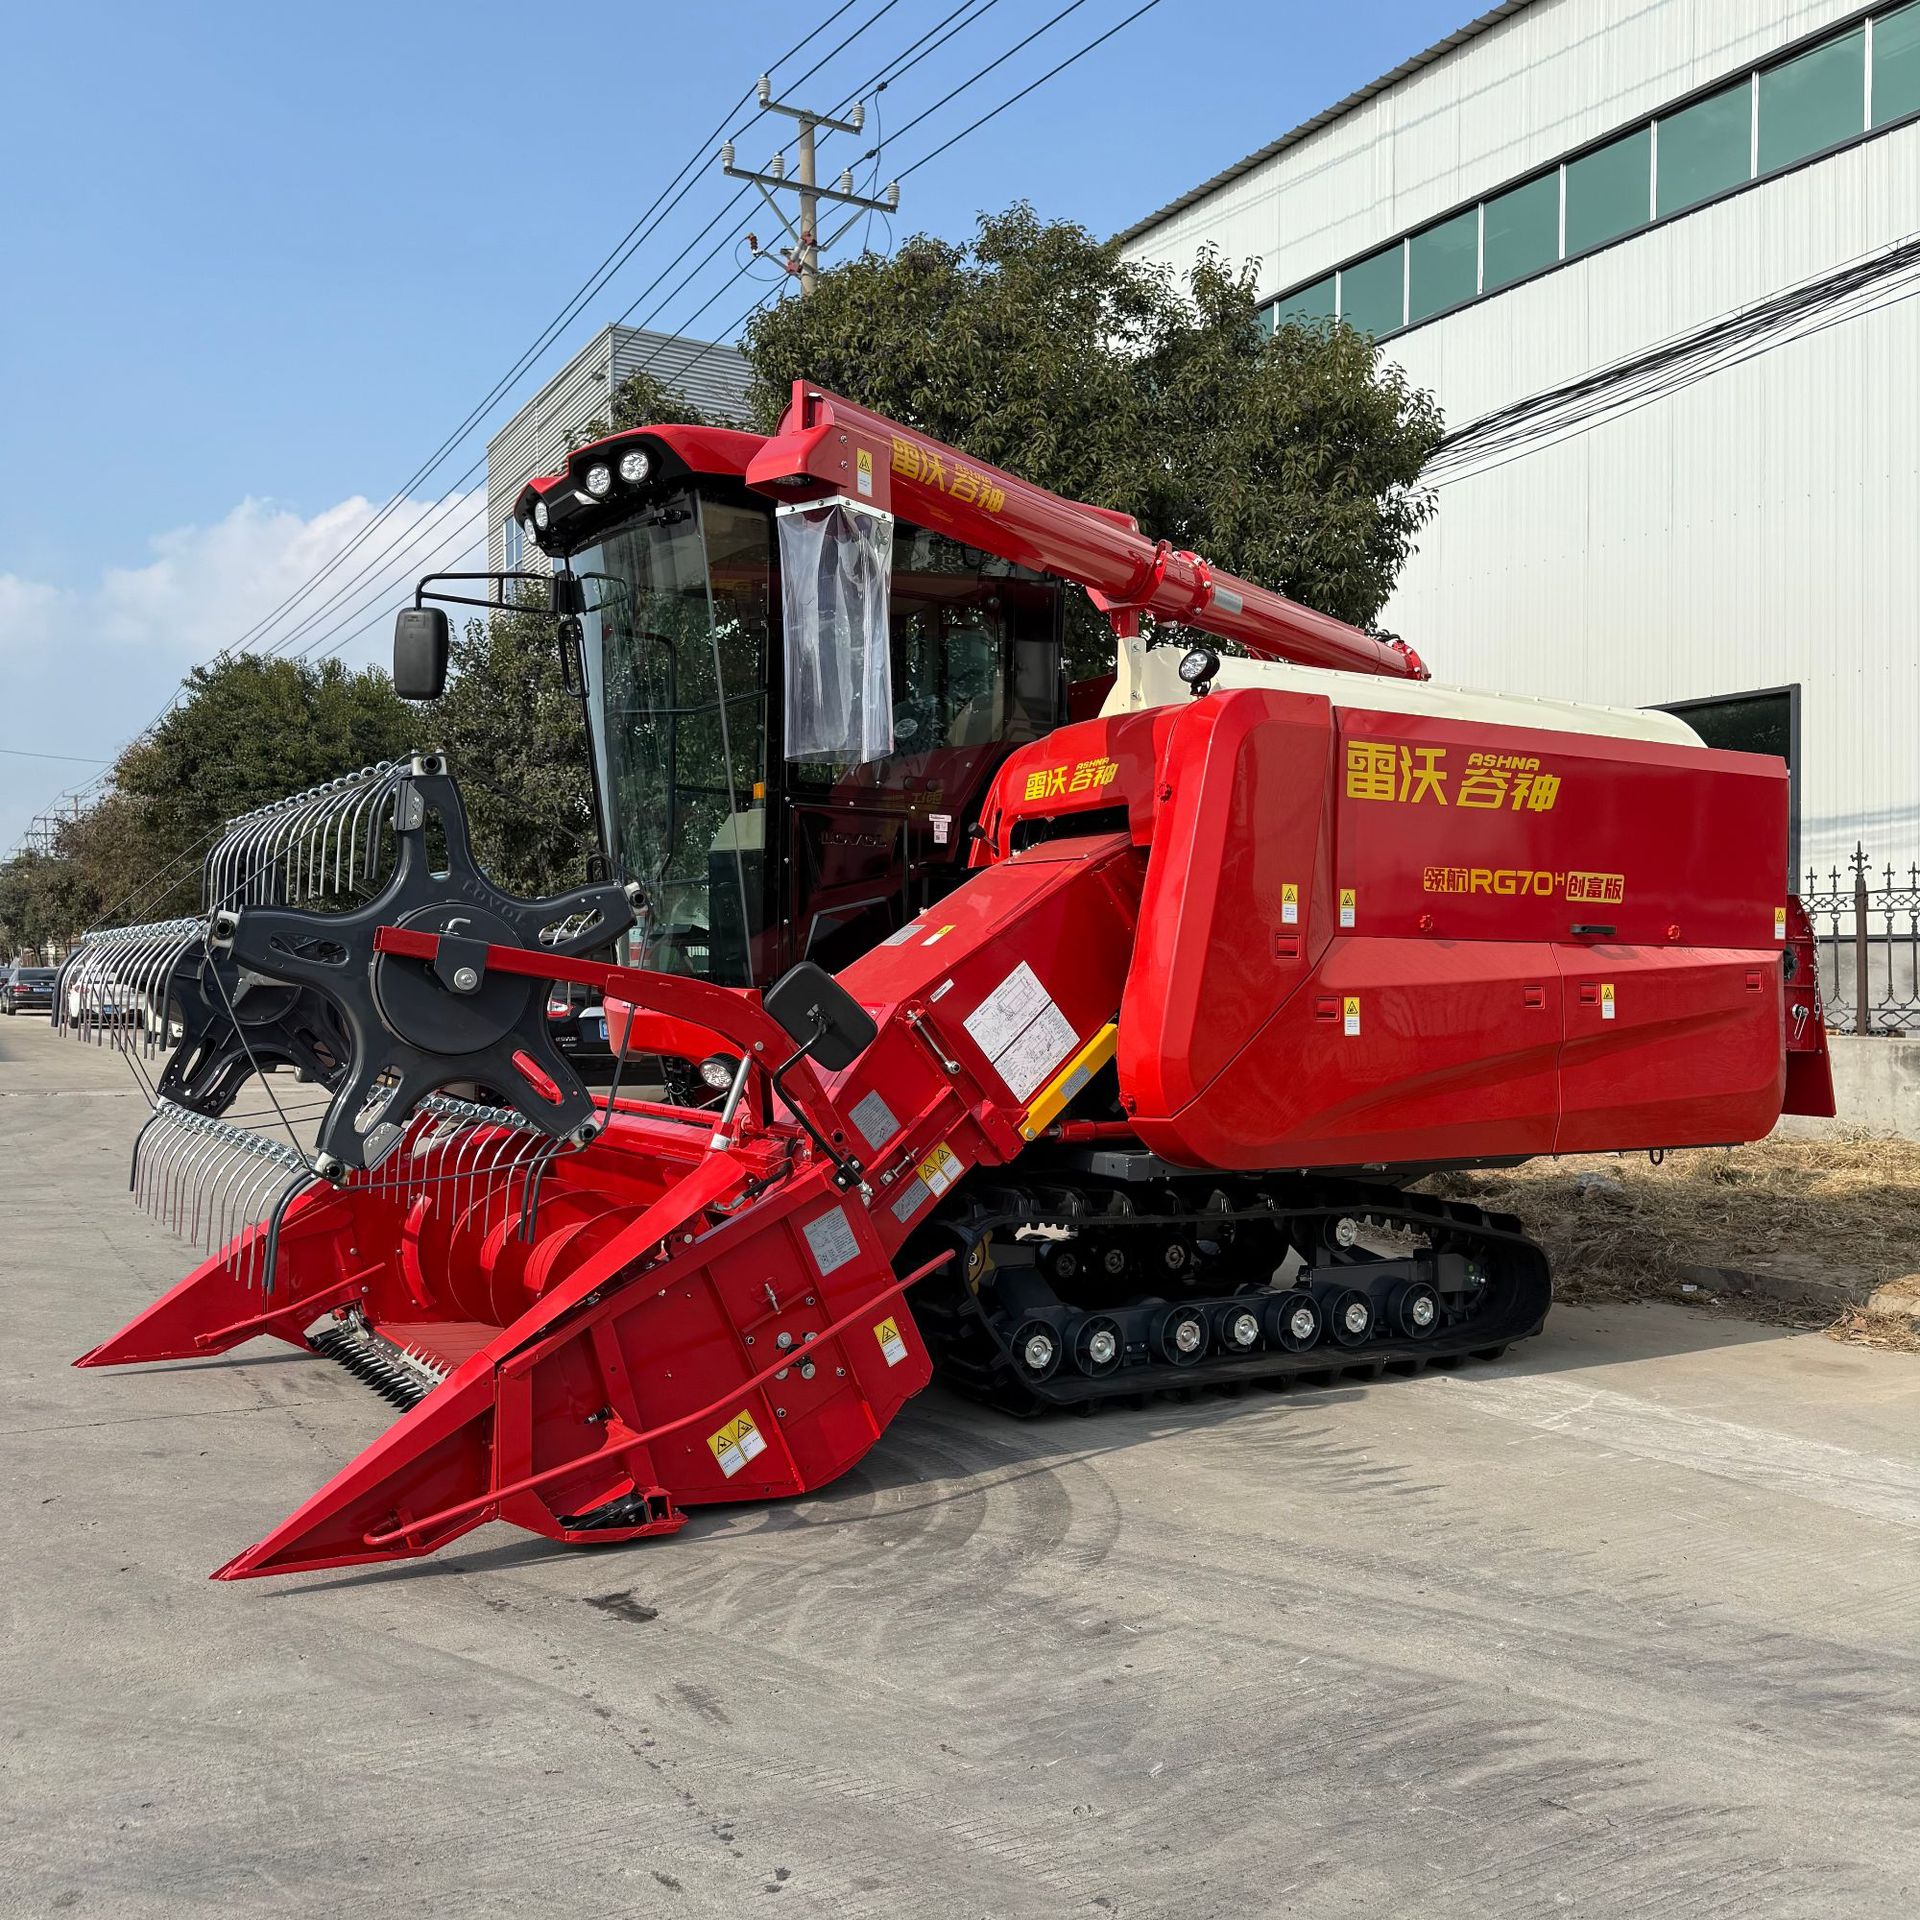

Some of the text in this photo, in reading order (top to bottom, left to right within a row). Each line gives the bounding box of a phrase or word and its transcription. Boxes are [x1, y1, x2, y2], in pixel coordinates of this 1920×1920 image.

[891, 435, 948, 492] 雷沃
[948, 470, 1005, 513] 谷神
[1076, 757, 1109, 770] ASHNA
[1346, 740, 1561, 812] 雷沃 谷神
[1468, 753, 1540, 771] ASHNA
[1024, 763, 1119, 801] 雷沃 谷神
[1424, 868, 1468, 893] 领航
[1566, 873, 1624, 902] 创富版
